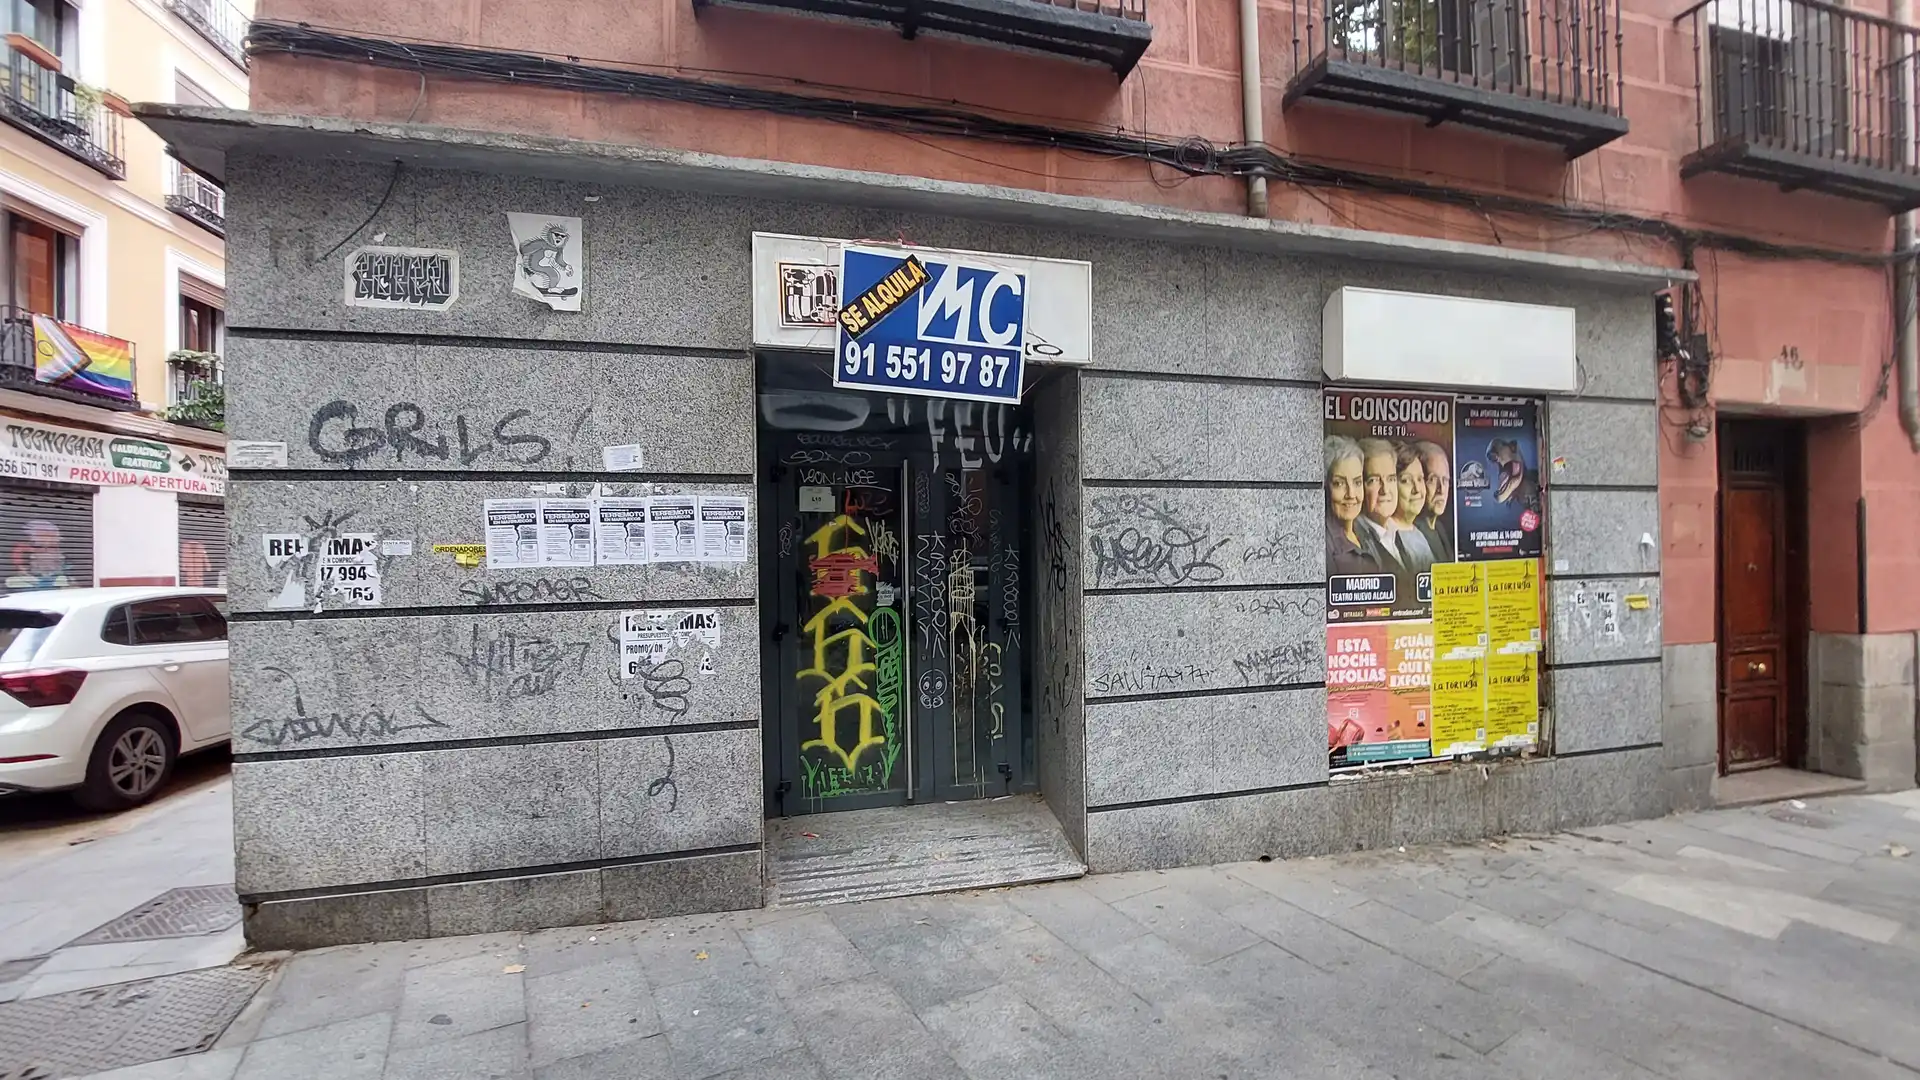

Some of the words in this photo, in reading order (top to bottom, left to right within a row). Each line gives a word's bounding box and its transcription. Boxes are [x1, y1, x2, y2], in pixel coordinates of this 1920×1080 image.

[841, 305, 867, 333] SE
[861, 260, 926, 319] ALQUILA
[917, 260, 1021, 346] MC
[845, 341, 875, 377] 91
[885, 345, 931, 382] 551
[941, 351, 972, 385] 97
[979, 354, 1010, 389] 87
[1324, 396, 1346, 420] EL
[1350, 396, 1449, 423] CONSORCIO
[1372, 425, 1393, 436] ERES
[6, 424, 106, 459] TECNOCASA
[21, 461, 38, 476] 677
[41, 463, 59, 478] 981
[121, 457, 163, 471] GRATUITAS
[139, 474, 208, 492] APERTURA
[489, 512, 536, 521] TERREMOTO
[544, 512, 590, 520] TERREMOTO
[651, 509, 694, 517] TERREMOTO
[1346, 577, 1380, 591] MADRID
[1332, 592, 1353, 602] TEATRO
[1354, 591, 1372, 601] NUEVO
[1337, 638, 1371, 653] ESTA
[1328, 653, 1377, 669] NOCHE
